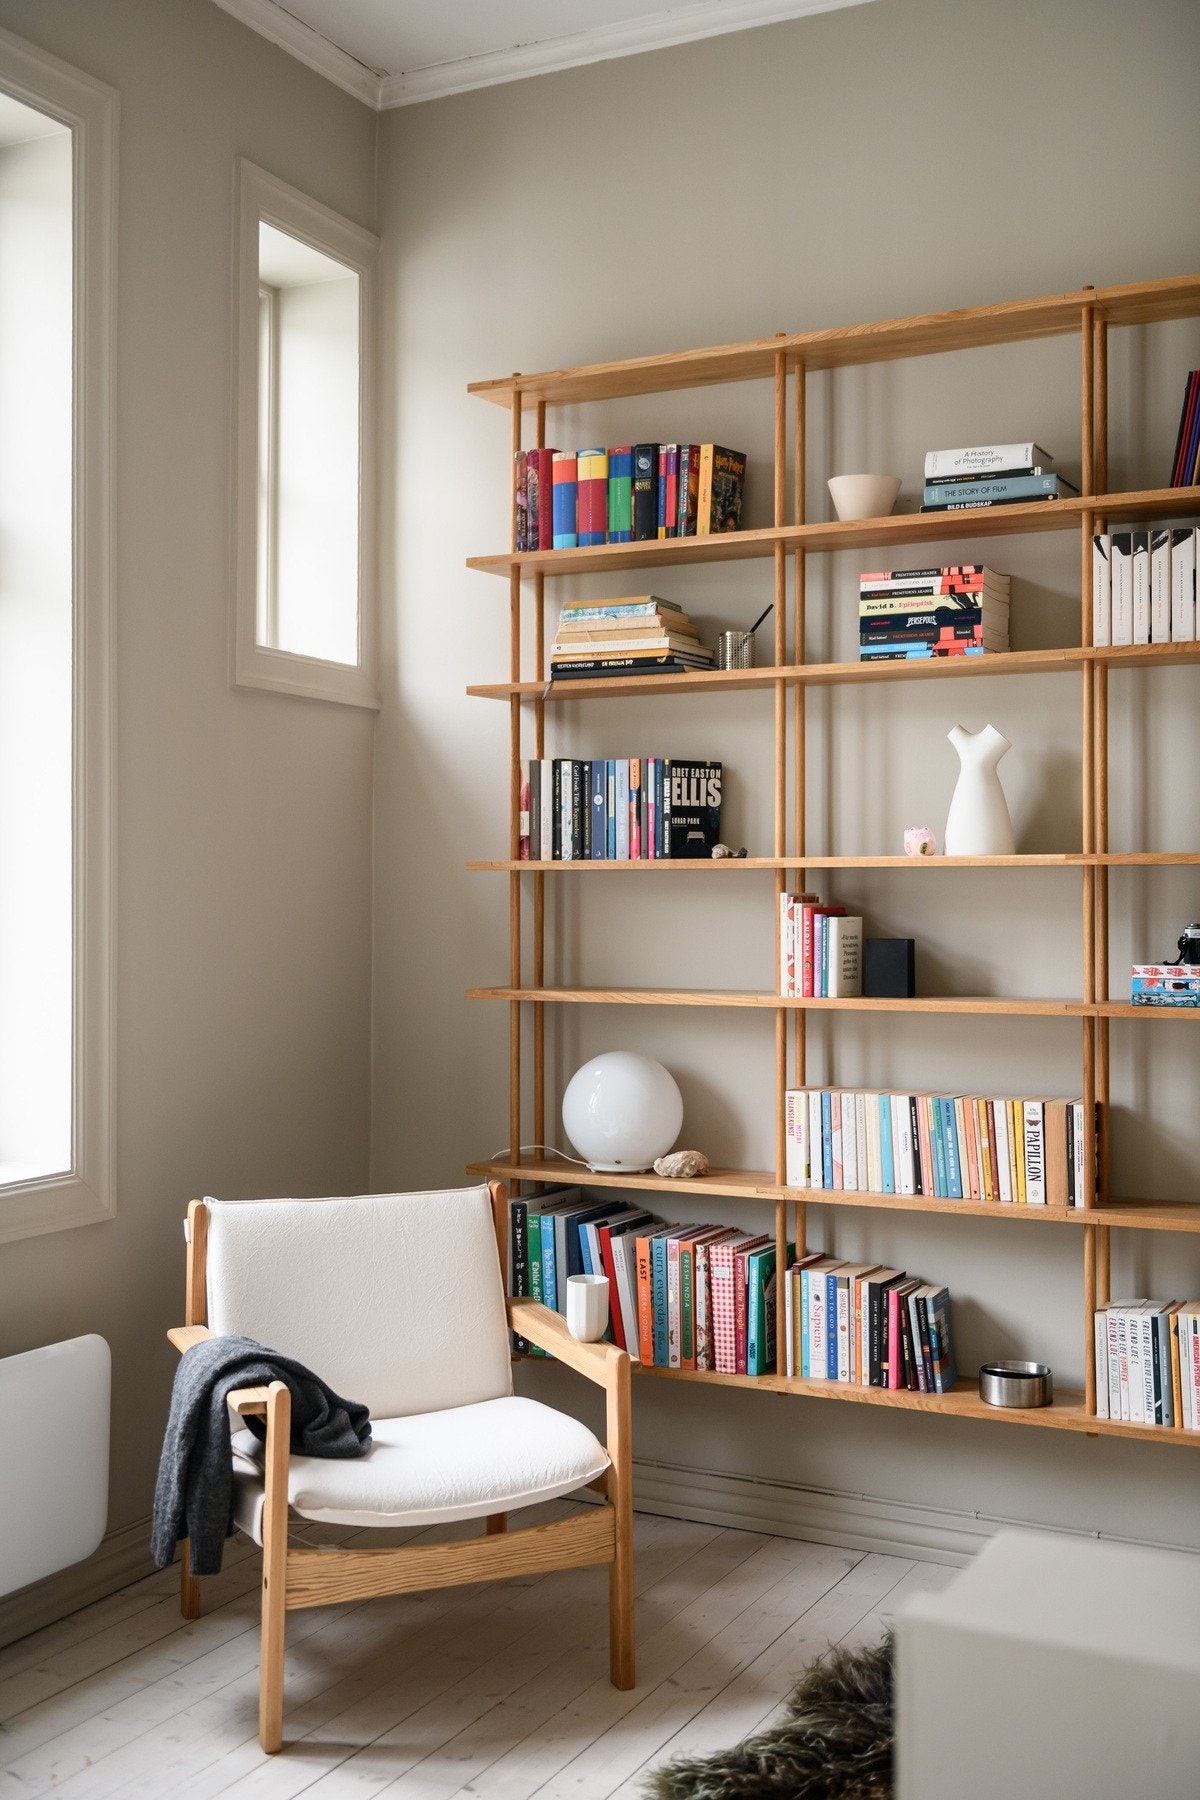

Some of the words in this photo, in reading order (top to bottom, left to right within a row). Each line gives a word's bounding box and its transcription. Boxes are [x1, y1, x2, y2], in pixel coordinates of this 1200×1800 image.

[715, 455, 729, 469] Harry
[729, 457, 744, 475] Potter
[963, 456, 1004, 465] Photography
[958, 488, 979, 496] STORY
[966, 501, 992, 509] BUDSKAP
[867, 603, 887, 611] David
[898, 600, 934, 609] Epileptisk
[906, 616, 937, 628] PERSEPOLIS
[672, 767, 689, 777] BRET
[691, 768, 721, 779] EASTON
[671, 777, 722, 807] ELLIS
[572, 807, 580, 839] Begynnelser
[787, 1095, 795, 1137] BALANSEKUNST
[1026, 1130, 1042, 1182] PAPILLON
[654, 1245, 664, 1276] curry
[531, 1261, 541, 1285] Edible
[655, 1279, 666, 1328] everyday
[829, 1302, 834, 1311] TO
[839, 1291, 847, 1320] ISHMAEL
[736, 1303, 745, 1331] Thought
[811, 1304, 824, 1349] Sapiens
[863, 1321, 868, 1330] OF
[1109, 1317, 1117, 1343] ERLEND
[1130, 1319, 1138, 1344] ERLEND
[1142, 1320, 1150, 1344] ERLEND
[1109, 1344, 1118, 1356] LOE
[1131, 1345, 1139, 1357] LOE
[1143, 1345, 1151, 1357] LOE
[1120, 1355, 1128, 1382] DOPPLER
[1144, 1358, 1152, 1377] VOLVO
[1145, 1377, 1153, 1413] LASTVAGNAR
